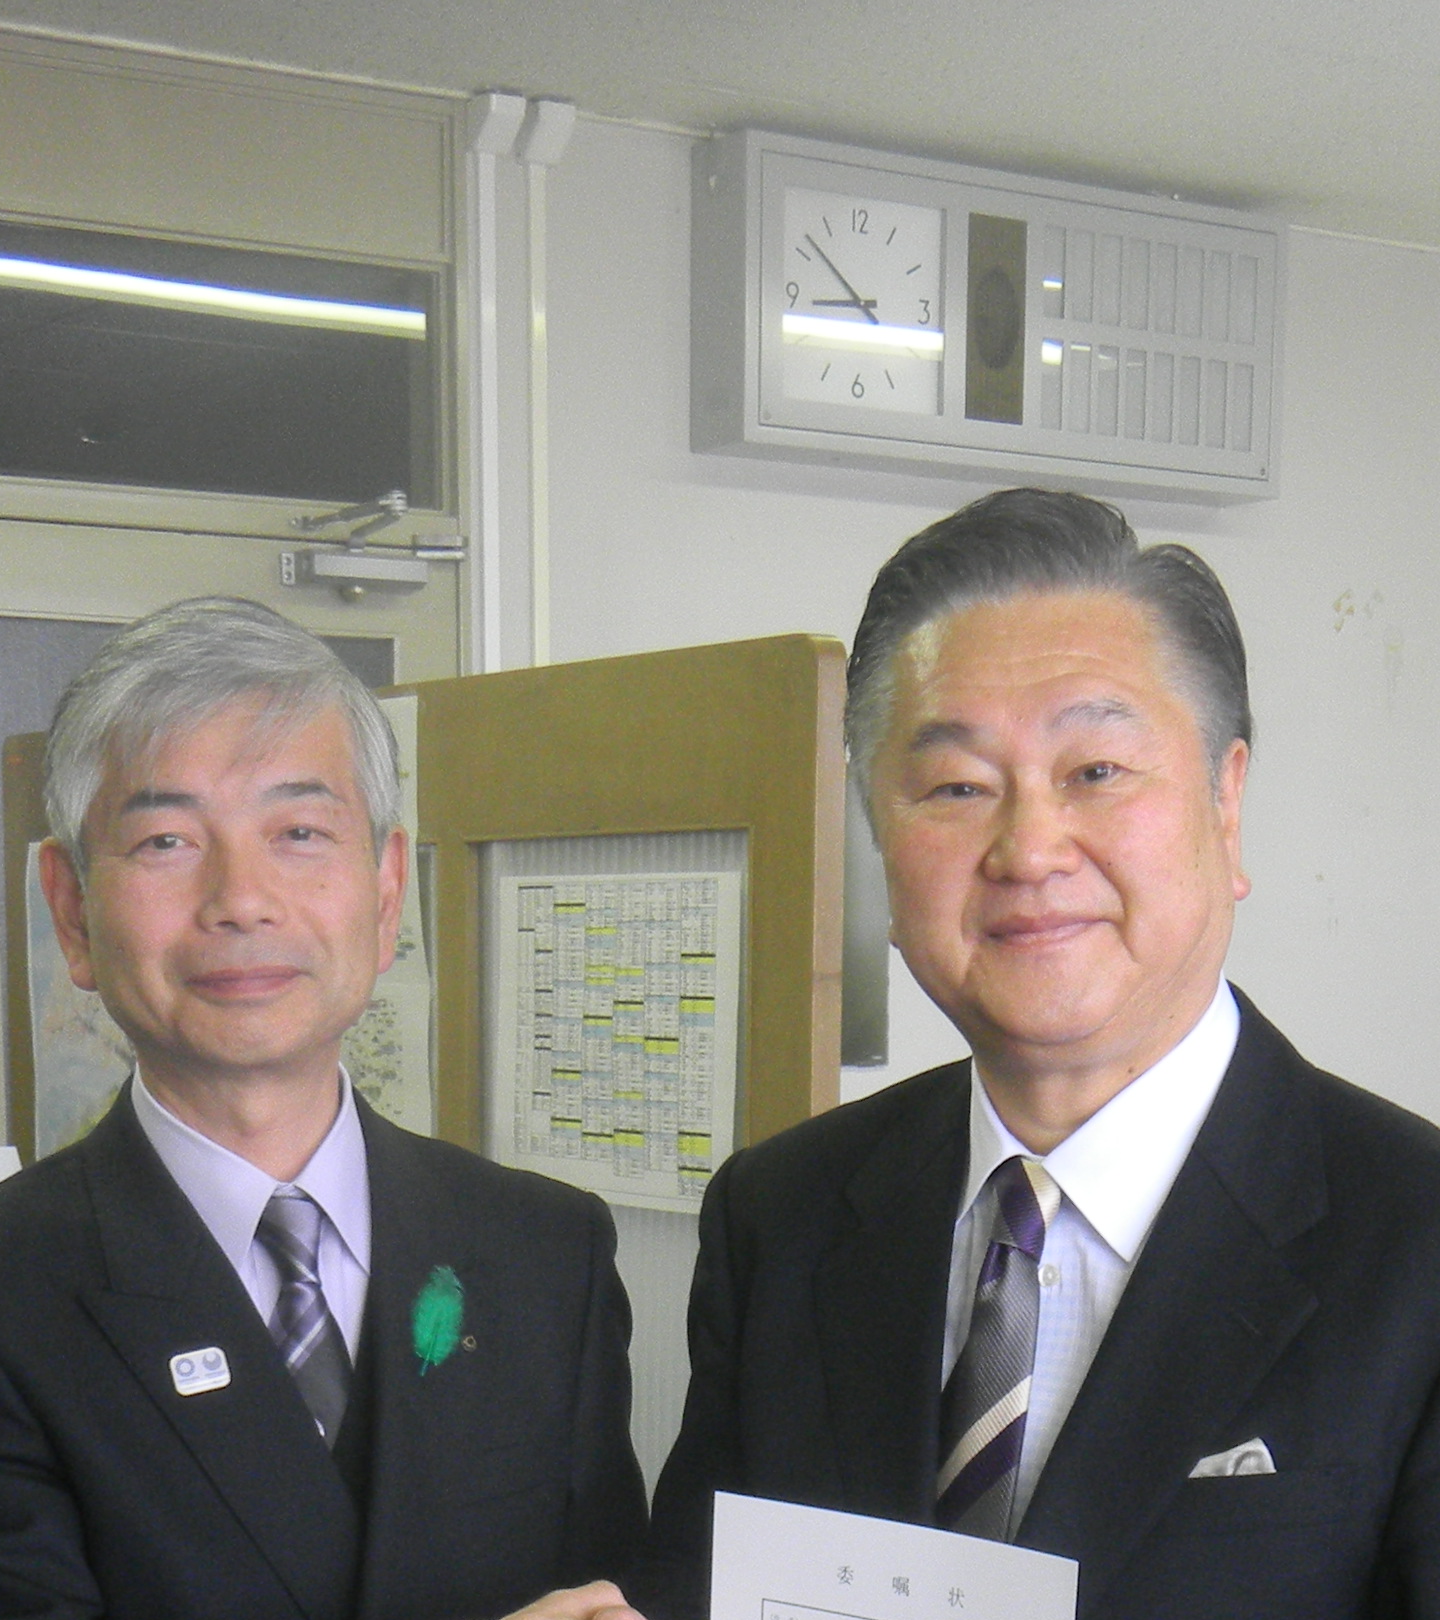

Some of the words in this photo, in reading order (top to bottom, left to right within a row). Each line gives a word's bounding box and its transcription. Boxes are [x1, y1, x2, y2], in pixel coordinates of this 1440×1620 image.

[851, 208, 869, 235] 12
[785, 281, 800, 309] 9
[917, 298, 931, 325] 3
[851, 373, 865, 399] 6
